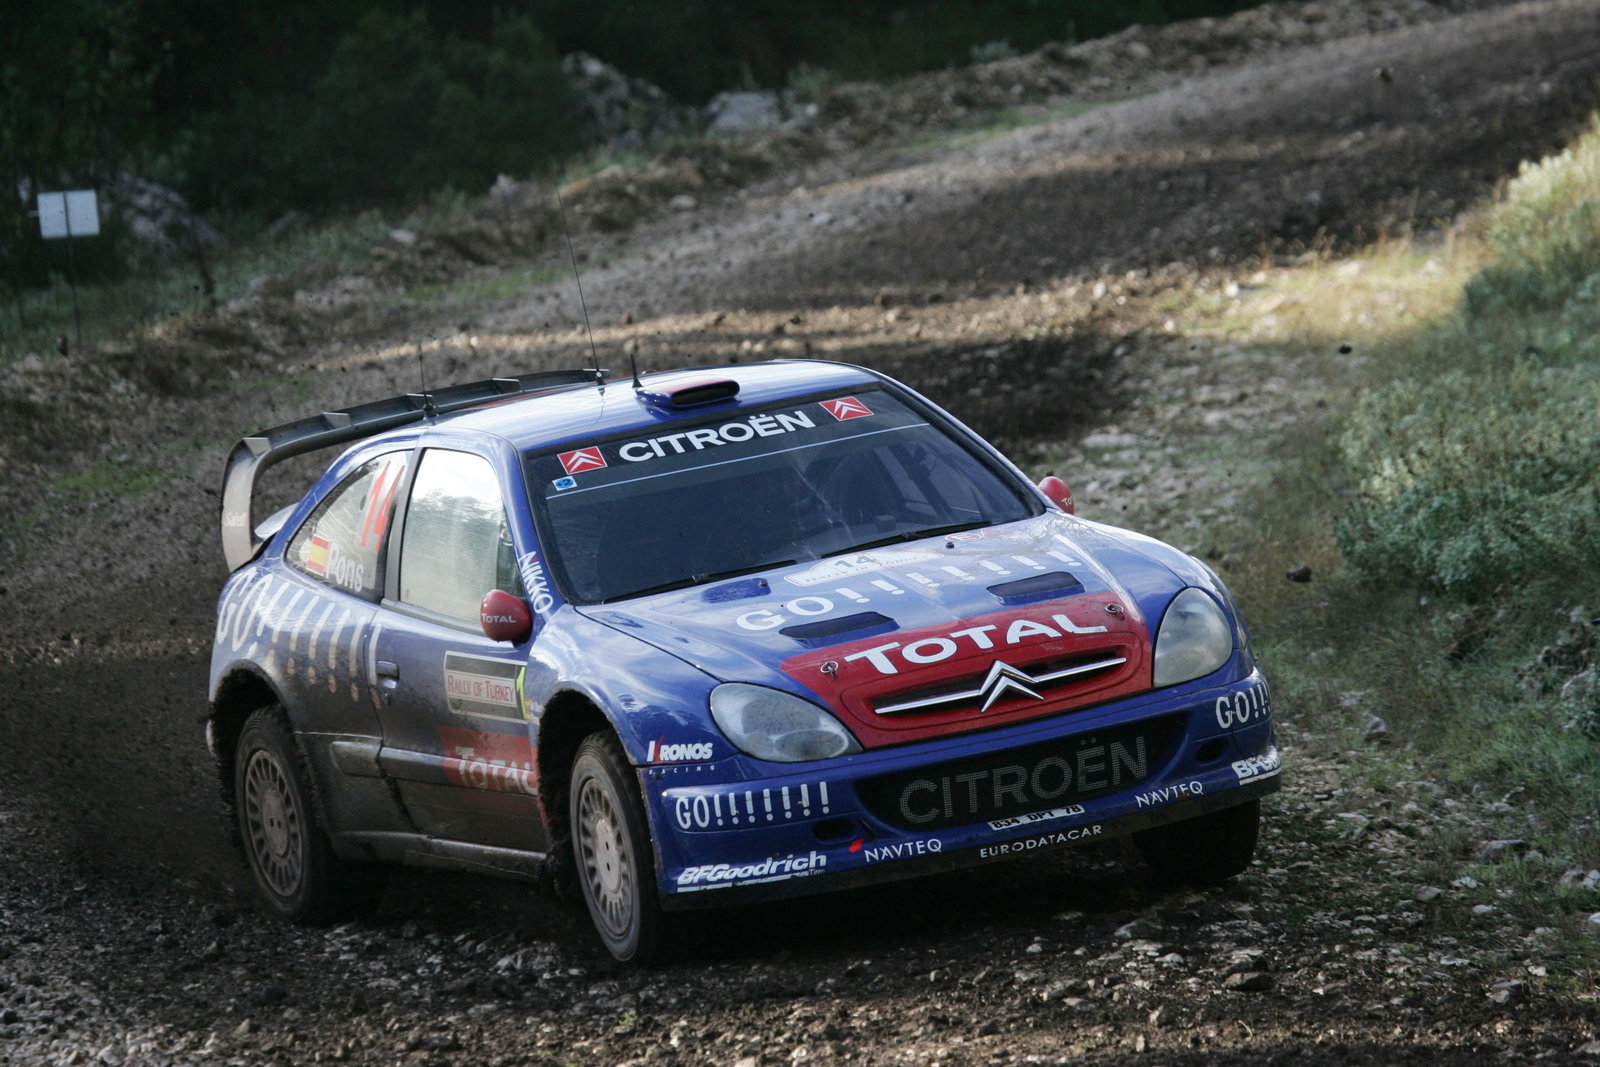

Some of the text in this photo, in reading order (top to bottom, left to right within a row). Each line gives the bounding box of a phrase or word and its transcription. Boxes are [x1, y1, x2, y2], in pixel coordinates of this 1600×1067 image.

[618, 410, 816, 464] CITROËN
[324, 541, 364, 592] Pons
[517, 551, 553, 614] NIKKO
[480, 612, 518, 624] TOTAL
[844, 614, 1109, 675] TOTAL
[447, 674, 514, 702] RALLY OF TURKEY
[646, 735, 714, 764] KRONOS
[899, 736, 1149, 825] CITROËN
[1136, 781, 1204, 809] NAVTEQ
[1064, 804, 1082, 814] 78
[864, 838, 943, 863] NAVTEQ
[979, 824, 1103, 858] EURODATACAR
[677, 850, 827, 885] BFGoodrich
